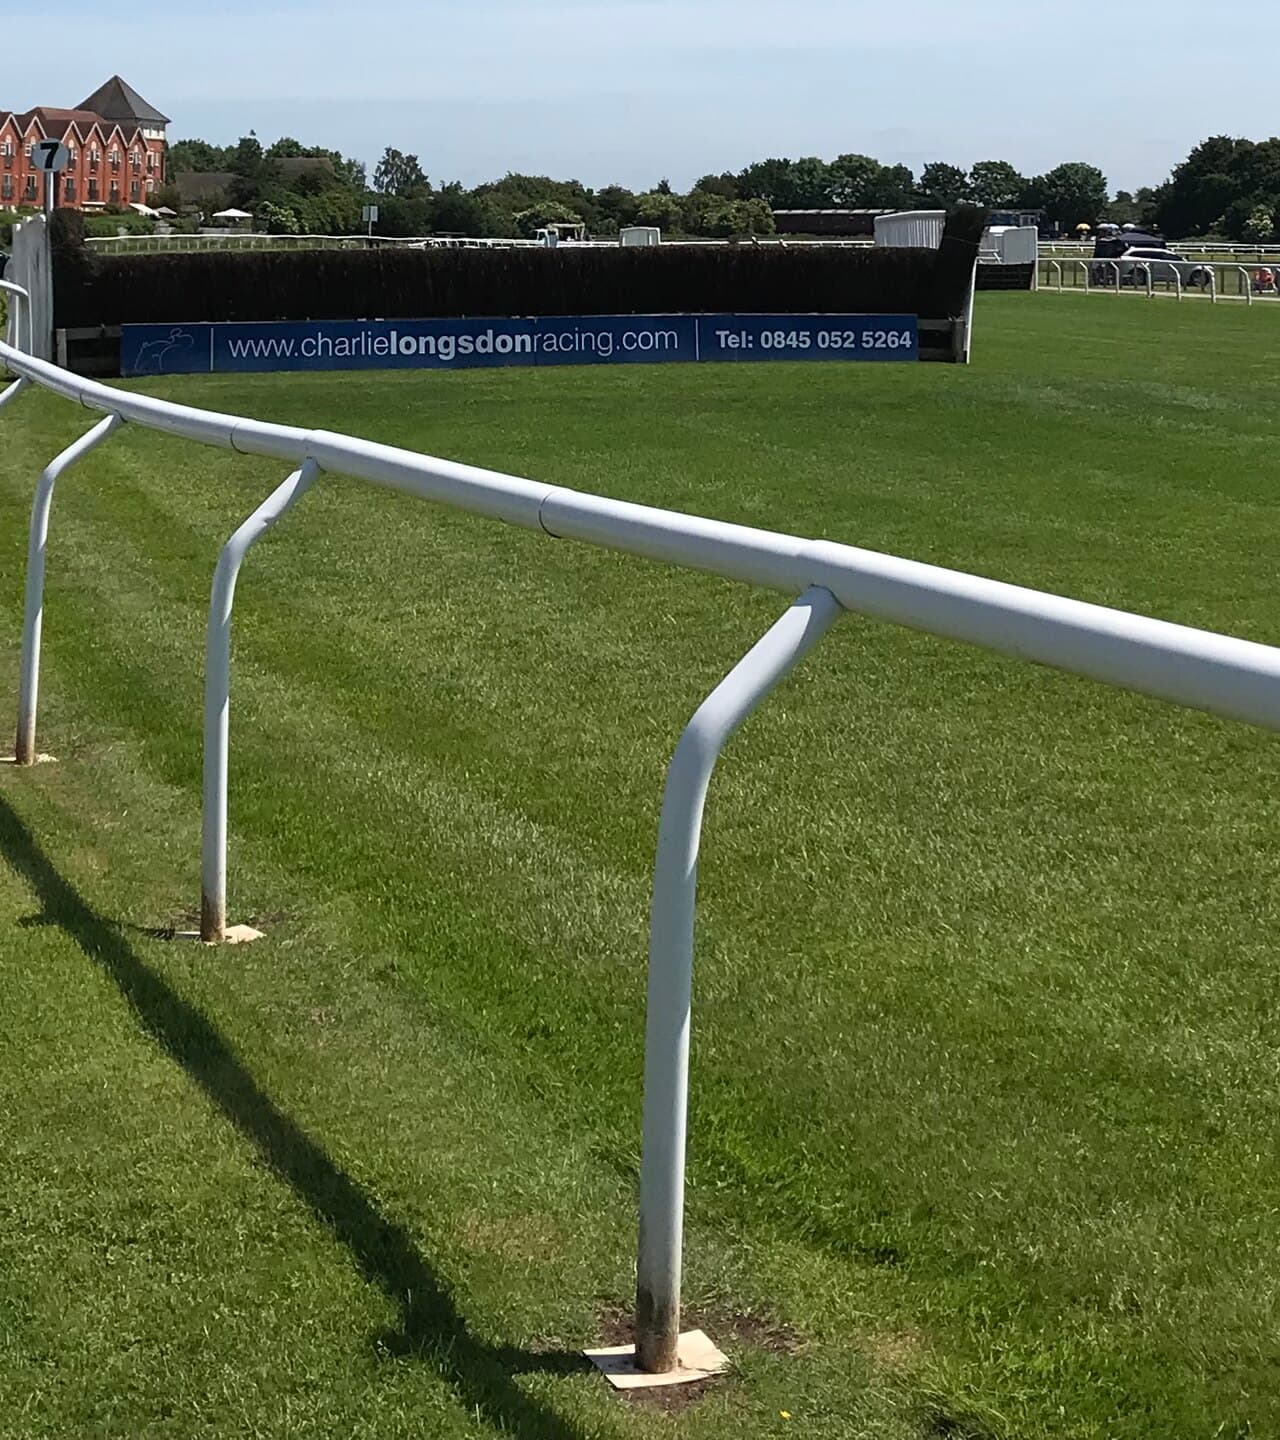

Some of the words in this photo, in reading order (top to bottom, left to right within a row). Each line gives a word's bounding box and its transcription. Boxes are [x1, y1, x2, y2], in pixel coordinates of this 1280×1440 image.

[40, 142, 60, 169] 7
[228, 327, 679, 360] www.charlielongsdonracing.com
[715, 330, 753, 348] Tel:
[760, 330, 811, 348] 0845
[817, 330, 856, 348] 052
[861, 330, 913, 348] 5264
